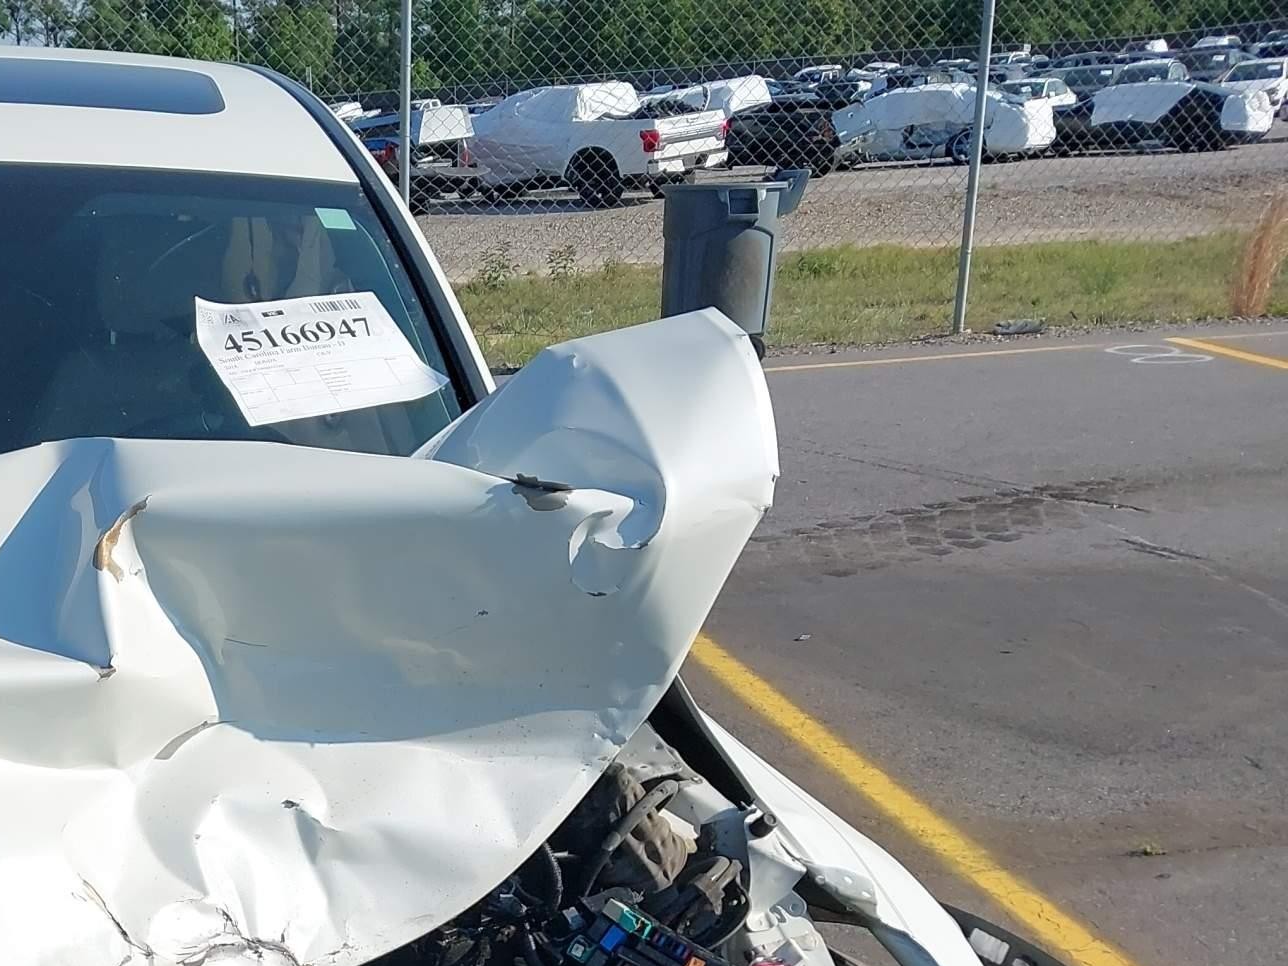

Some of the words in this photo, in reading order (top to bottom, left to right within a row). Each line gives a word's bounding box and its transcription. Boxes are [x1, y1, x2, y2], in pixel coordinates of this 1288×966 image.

[224, 317, 371, 354] 45166947
[219, 353, 244, 365] South
[244, 349, 279, 360] Carolina
